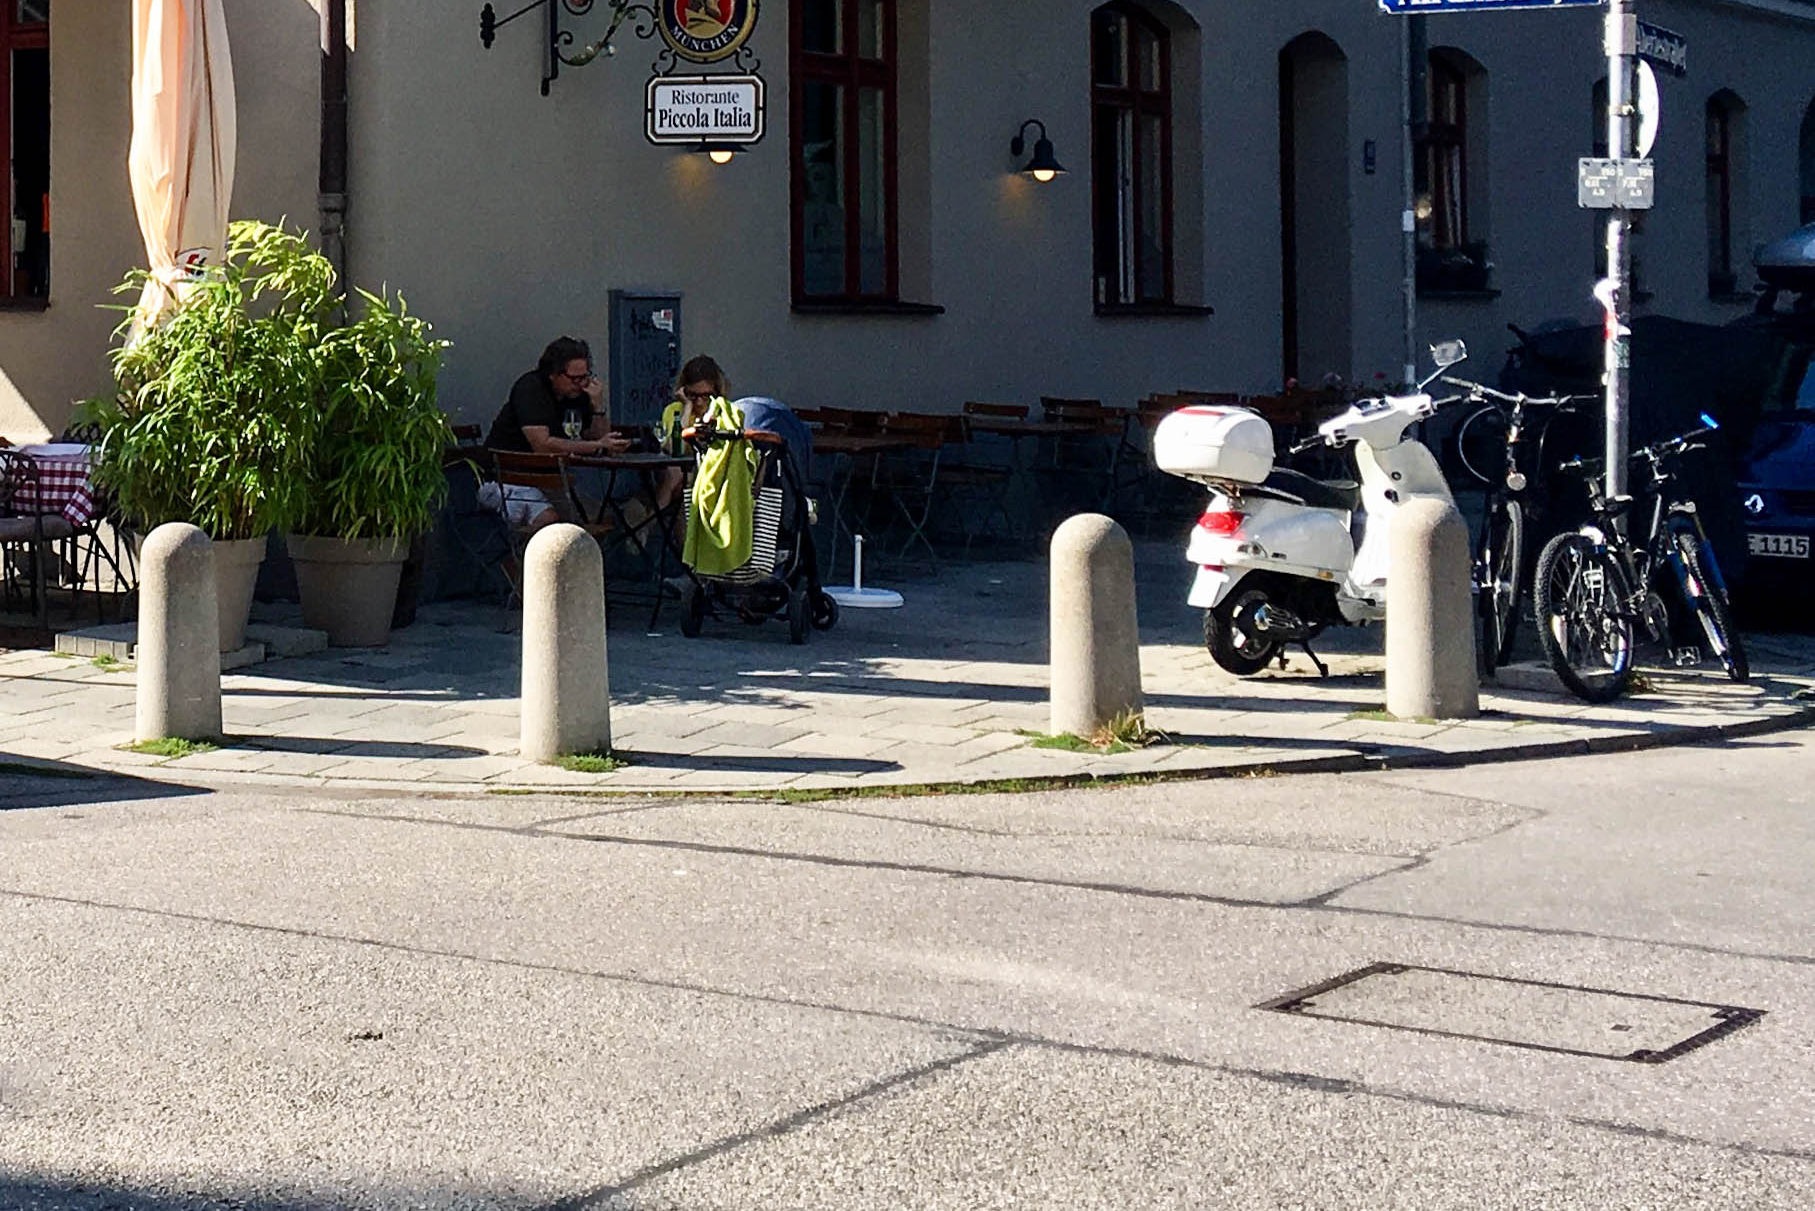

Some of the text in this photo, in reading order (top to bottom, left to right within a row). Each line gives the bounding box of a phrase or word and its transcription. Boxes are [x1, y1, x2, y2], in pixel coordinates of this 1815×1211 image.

[671, 89, 740, 105] Ristorante
[658, 106, 752, 128] Piccola Italia
